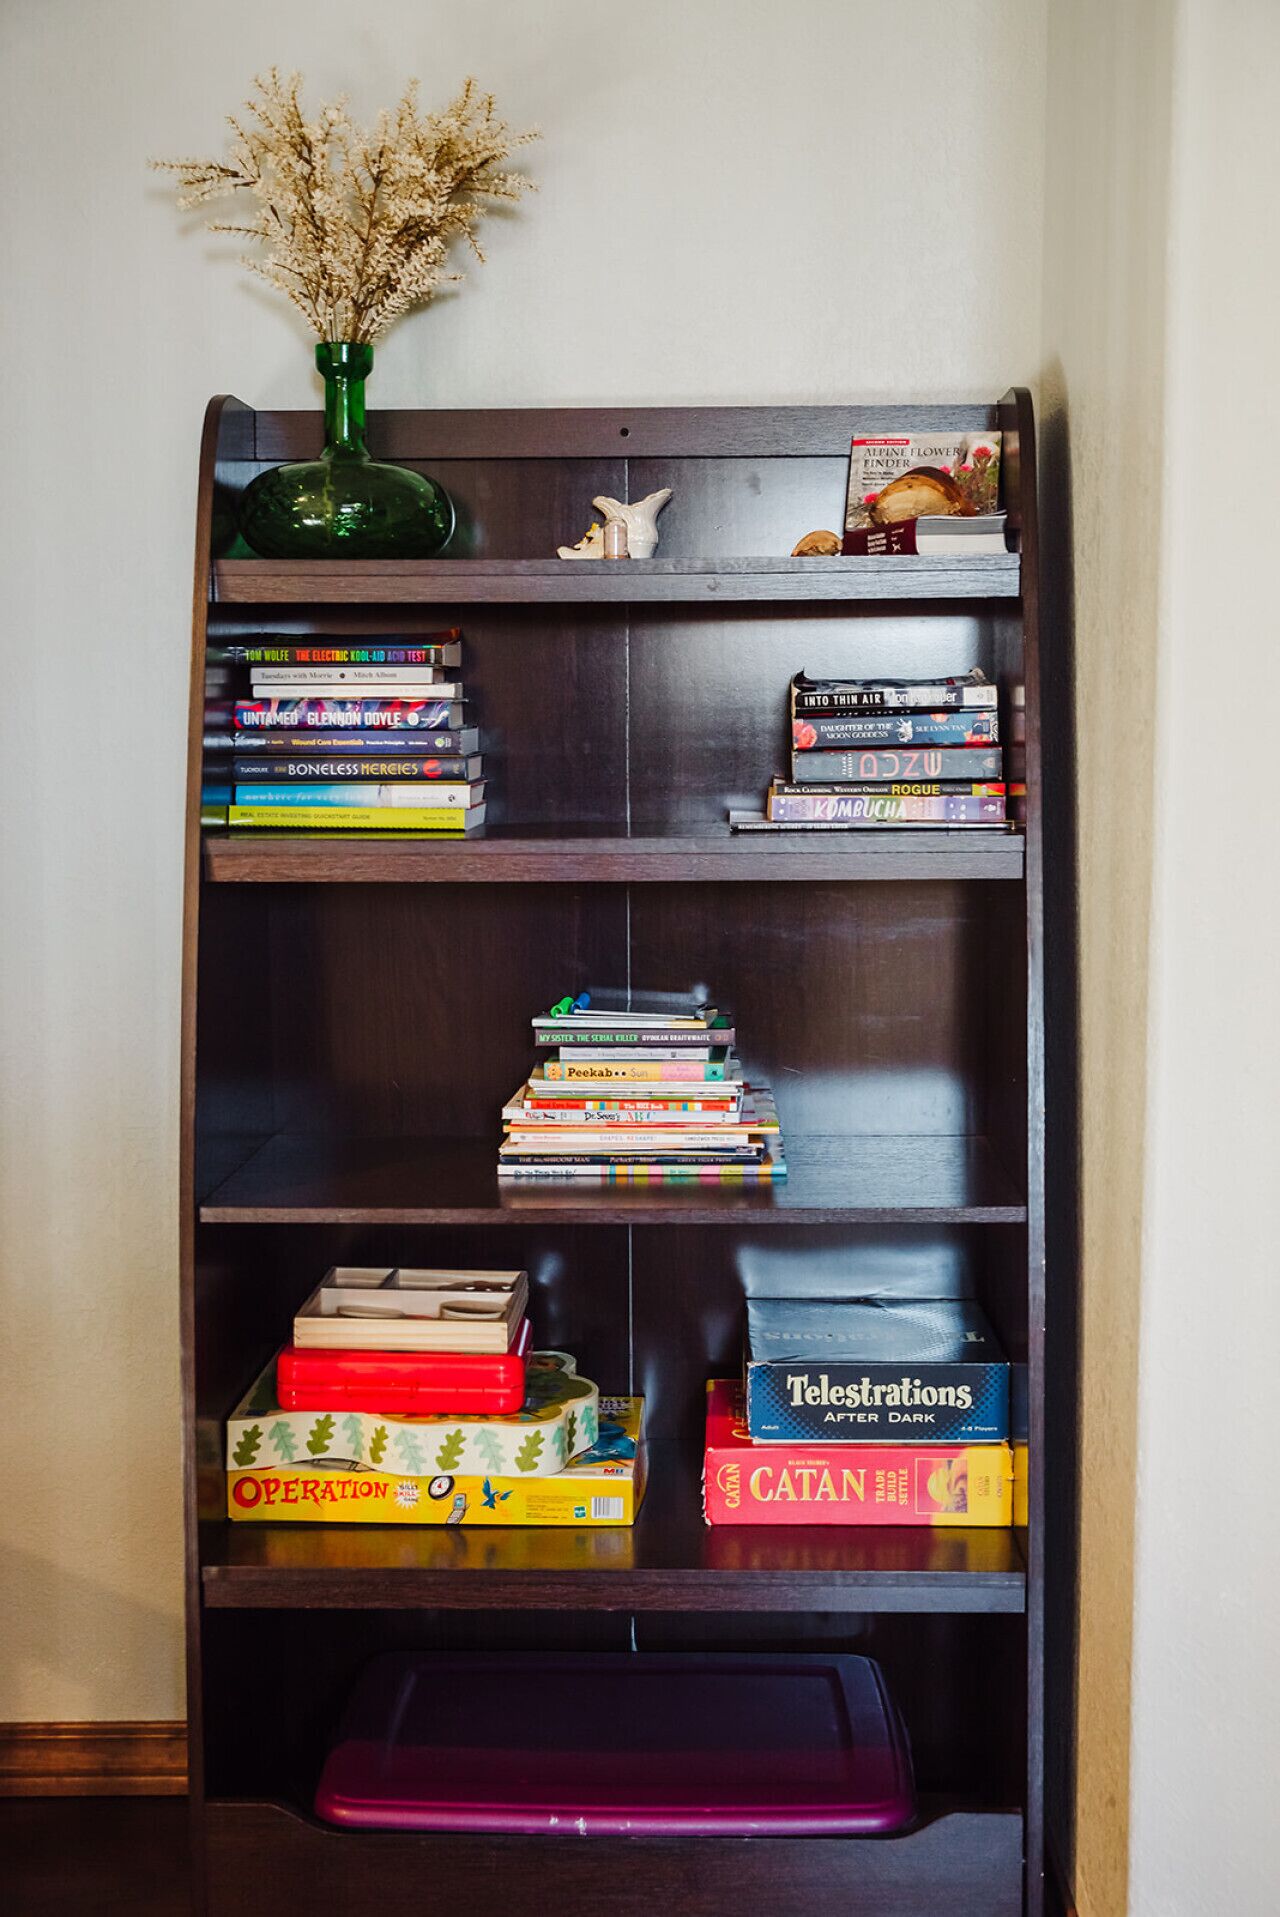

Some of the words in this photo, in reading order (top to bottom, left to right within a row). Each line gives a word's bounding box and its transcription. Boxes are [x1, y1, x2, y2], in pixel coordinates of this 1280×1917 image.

[864, 447, 907, 457] ALPINE
[910, 447, 961, 457] FLOWER
[863, 458, 911, 468] FINDER
[246, 650, 262, 661] TOM
[264, 650, 289, 661] WOLFE
[296, 650, 310, 662] THE
[312, 650, 349, 662] ELECTRIC
[350, 650, 385, 662] KOOL-AID
[387, 650, 406, 662] ACID
[407, 650, 426, 662] TEST
[260, 672, 291, 680] Tuesdays
[804, 695, 829, 707] INTO
[833, 694, 858, 706] THIN
[862, 693, 882, 704] AIR
[243, 712, 298, 726] UNTAMED
[307, 712, 362, 726] GLENNON
[364, 712, 401, 726] DOYLE
[820, 724, 863, 733] DAUGHTER
[878, 722, 894, 730] THE
[288, 764, 359, 775] BONELESS
[361, 763, 418, 775] MERCIES
[892, 784, 940, 795] ROGUE
[295, 792, 313, 803] for
[813, 798, 908, 818] KOMBUCHA
[539, 1034, 550, 1042] MY
[576, 1034, 589, 1042] THE
[591, 1034, 613, 1042] SERIAL
[615, 1034, 638, 1042] KILLER
[630, 1067, 649, 1078] Sun
[787, 1375, 974, 1410] Telestrations
[824, 1412, 879, 1423] AFTER
[888, 1412, 936, 1423] DARK
[725, 1463, 741, 1508] CATAN
[750, 1466, 867, 1502] CATAN
[875, 1470, 886, 1503] TRADE
[886, 1470, 897, 1502] BUILD
[898, 1468, 909, 1505] SETTLE
[233, 1476, 390, 1509] OPERATION
